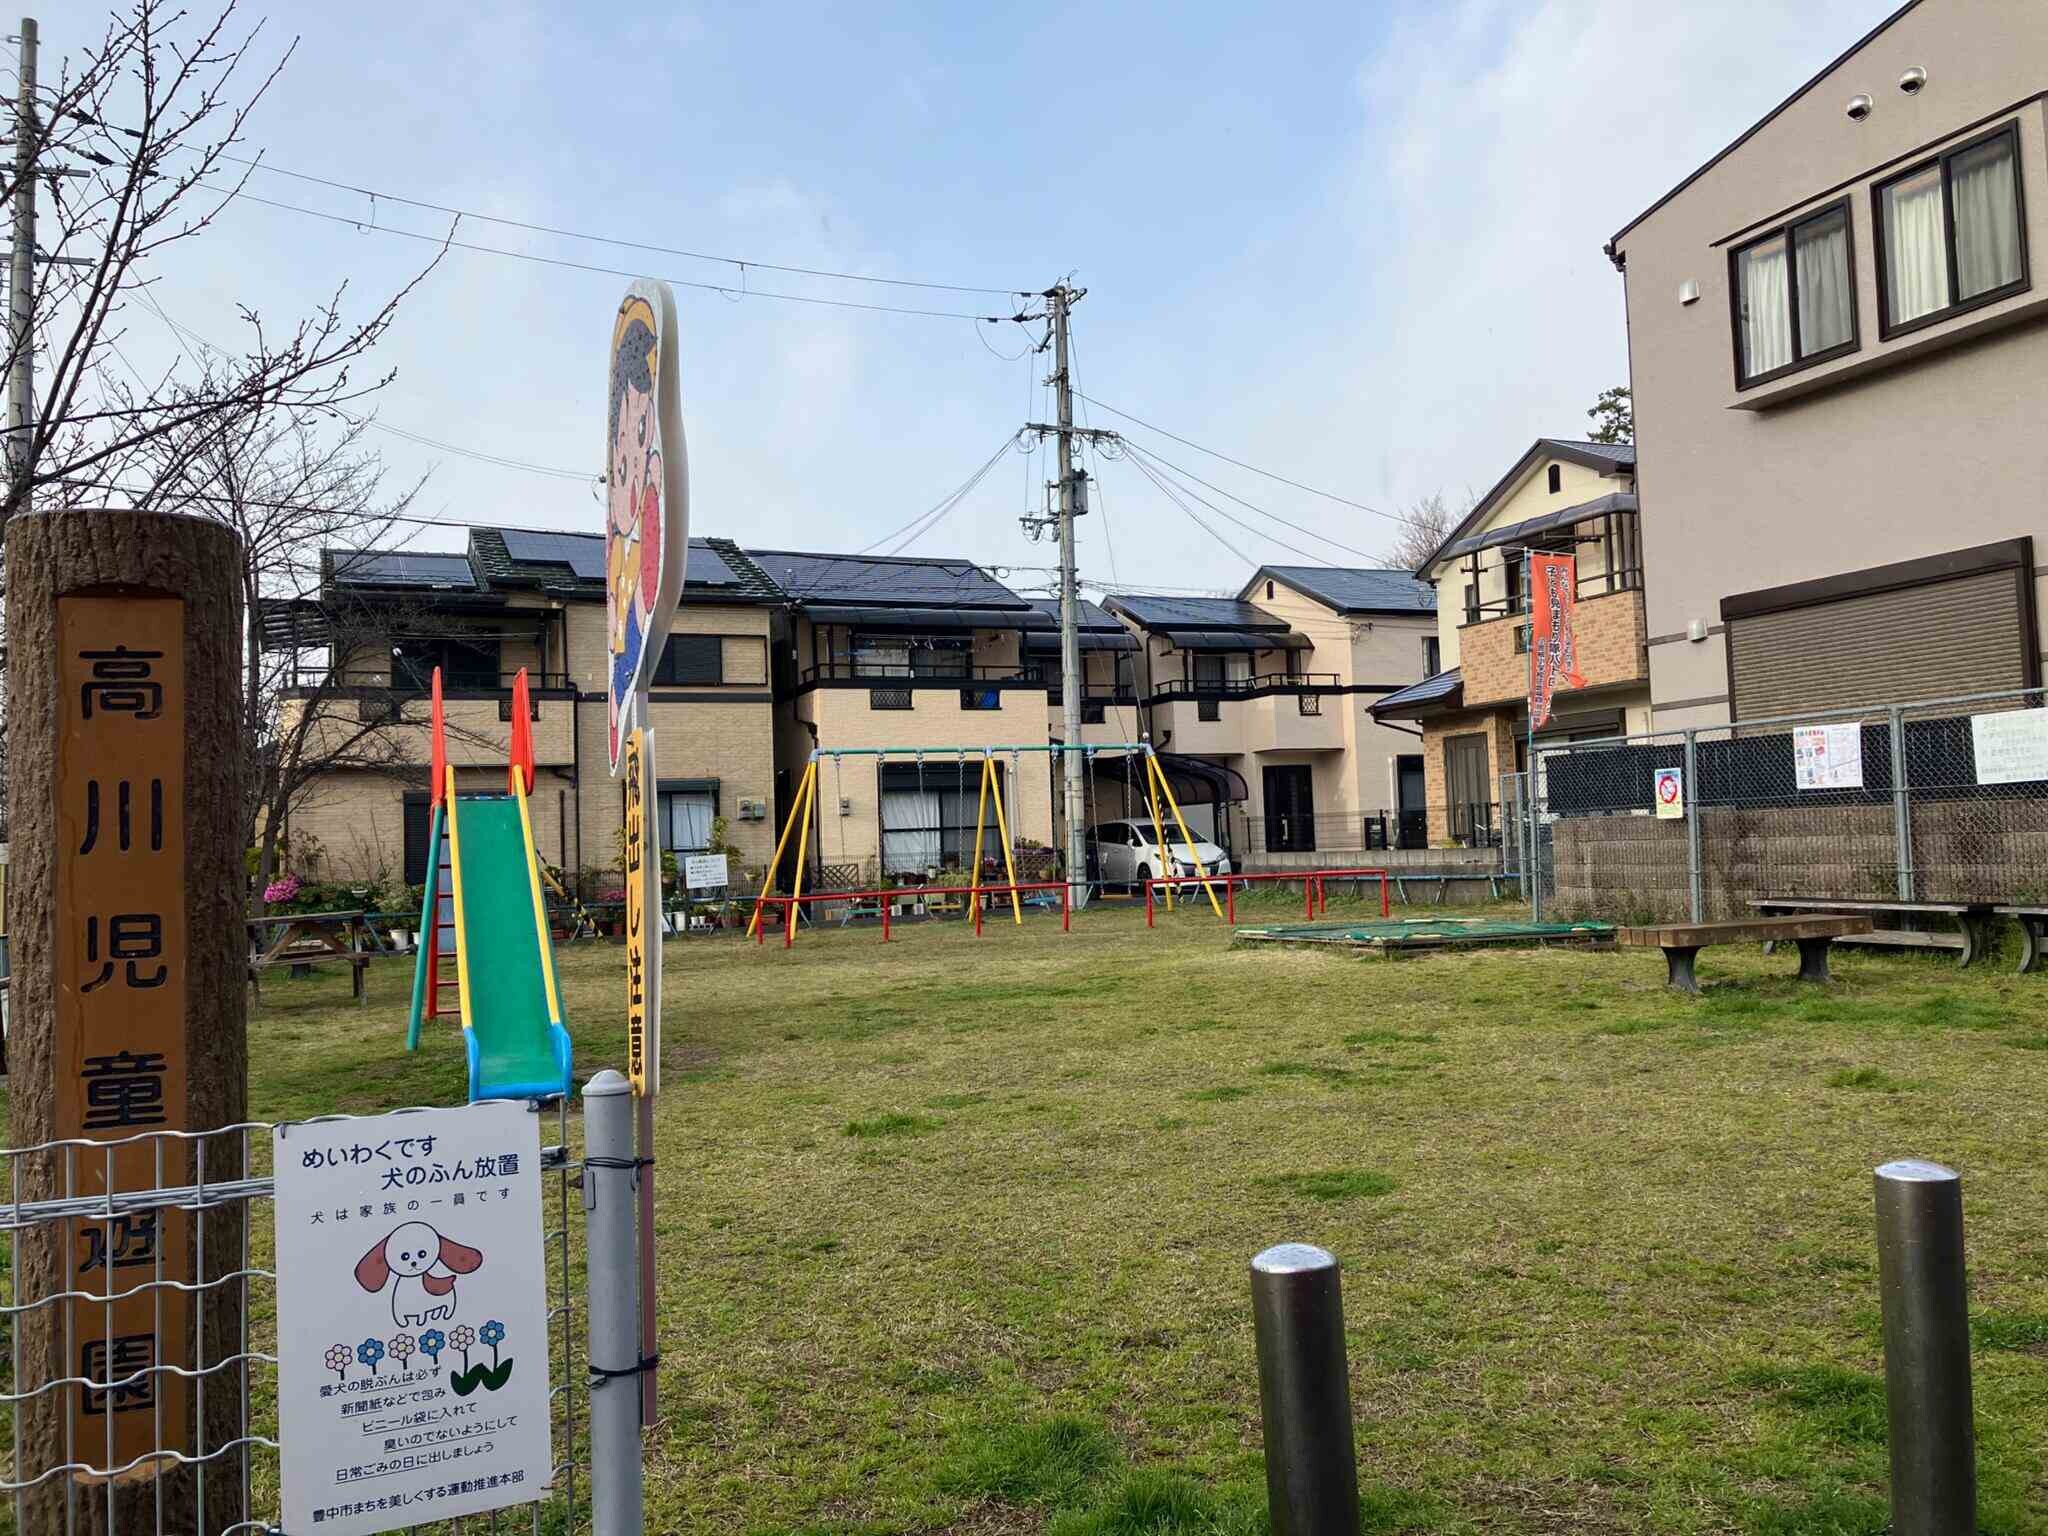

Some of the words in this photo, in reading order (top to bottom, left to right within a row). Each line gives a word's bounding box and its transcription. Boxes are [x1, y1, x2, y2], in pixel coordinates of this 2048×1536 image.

[79, 645, 167, 1414] 高川児童遊園
[302, 1134, 438, 1169] めいわくです
[381, 1153, 520, 1190] 犬のふん放置
[310, 1188, 510, 1225] 犬は家族の一員です
[341, 1387, 446, 1415] 新聞紙などで包み
[362, 1402, 478, 1433] ビニール袋に入れて
[336, 1441, 495, 1481] 日常ごみの日に出しましょう
[312, 1469, 525, 1522] 豊中市まちを美しくする運動推進本部
